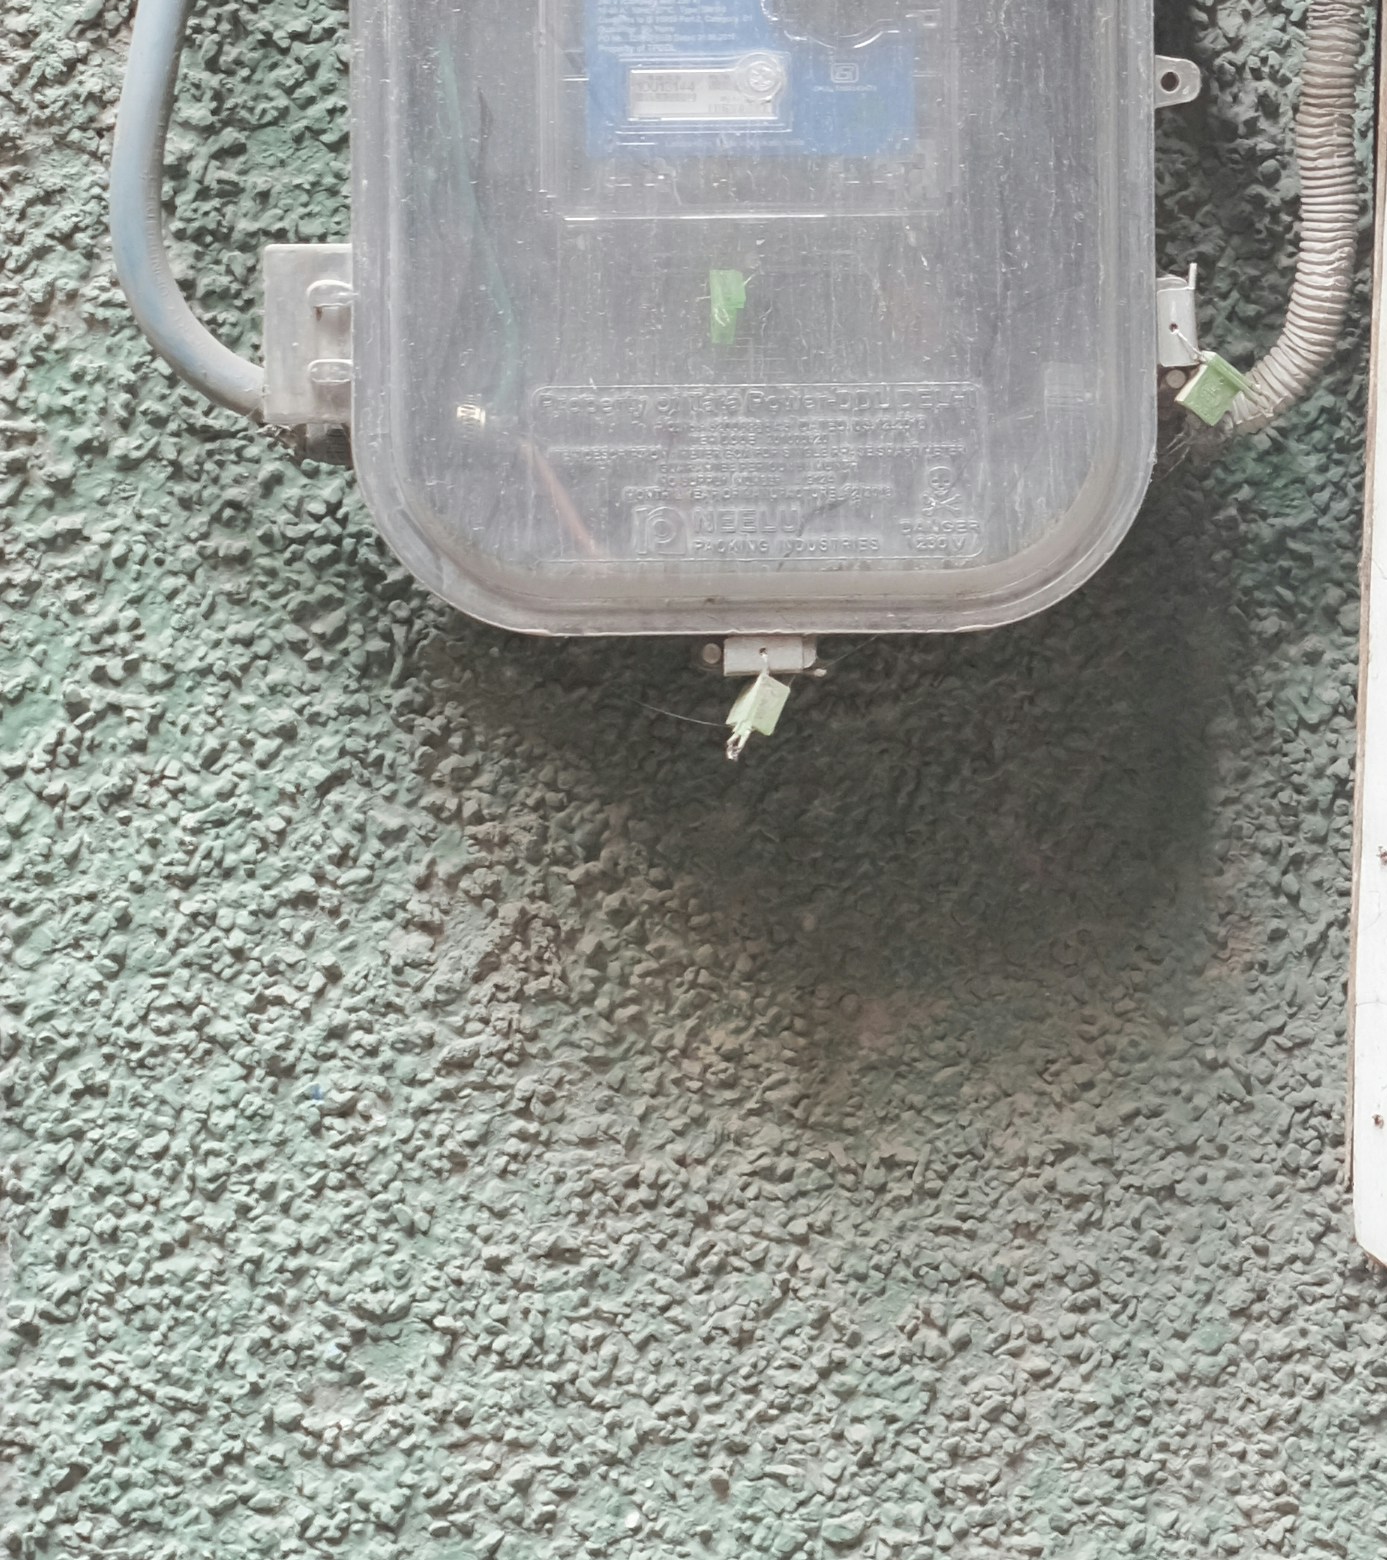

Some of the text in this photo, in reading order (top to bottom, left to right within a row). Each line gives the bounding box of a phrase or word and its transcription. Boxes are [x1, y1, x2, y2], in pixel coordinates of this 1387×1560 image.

[540, 391, 648, 419] Property
[692, 506, 803, 535] NEELU
[899, 519, 981, 535] DANGER
[693, 537, 881, 554] PACKING INDUSTRIES
